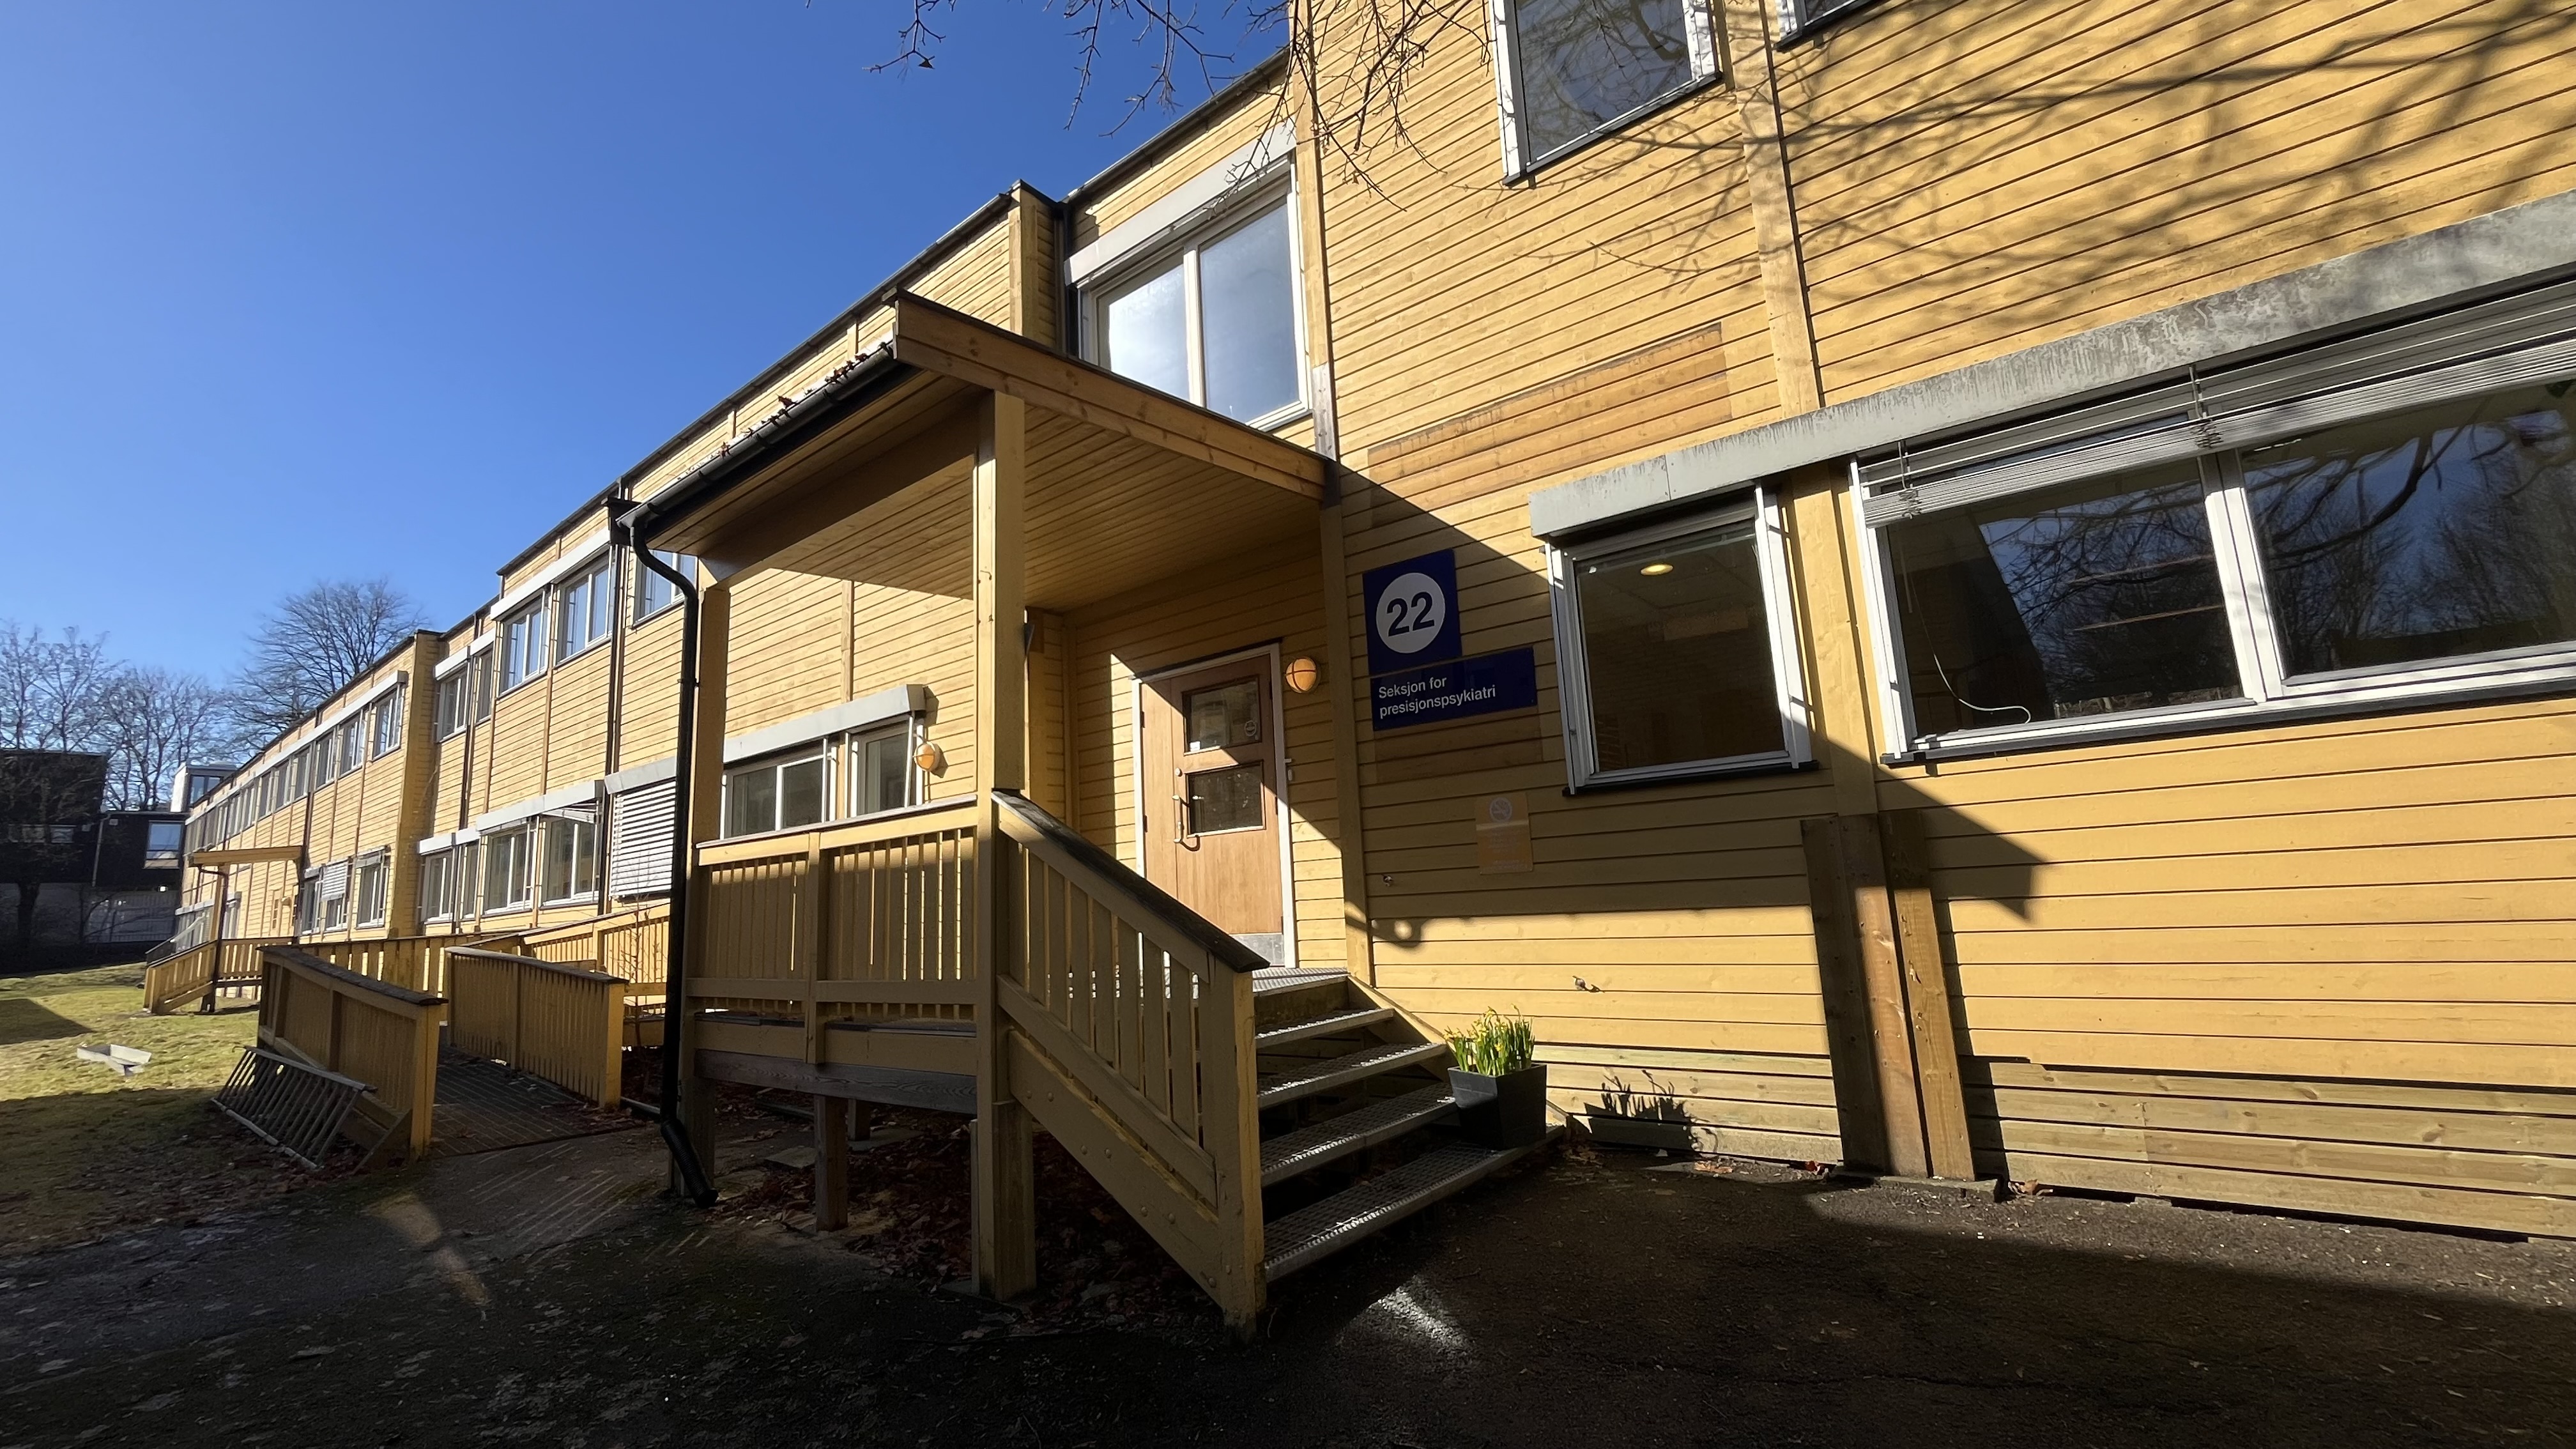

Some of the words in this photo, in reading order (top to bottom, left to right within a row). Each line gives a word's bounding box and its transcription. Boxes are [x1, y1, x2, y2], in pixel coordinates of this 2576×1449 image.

[1386, 591, 1435, 637] 22
[1379, 681, 1426, 699] Seksjon
[1429, 677, 1447, 689] for
[1379, 685, 1496, 719] presisjonspsykiatri
